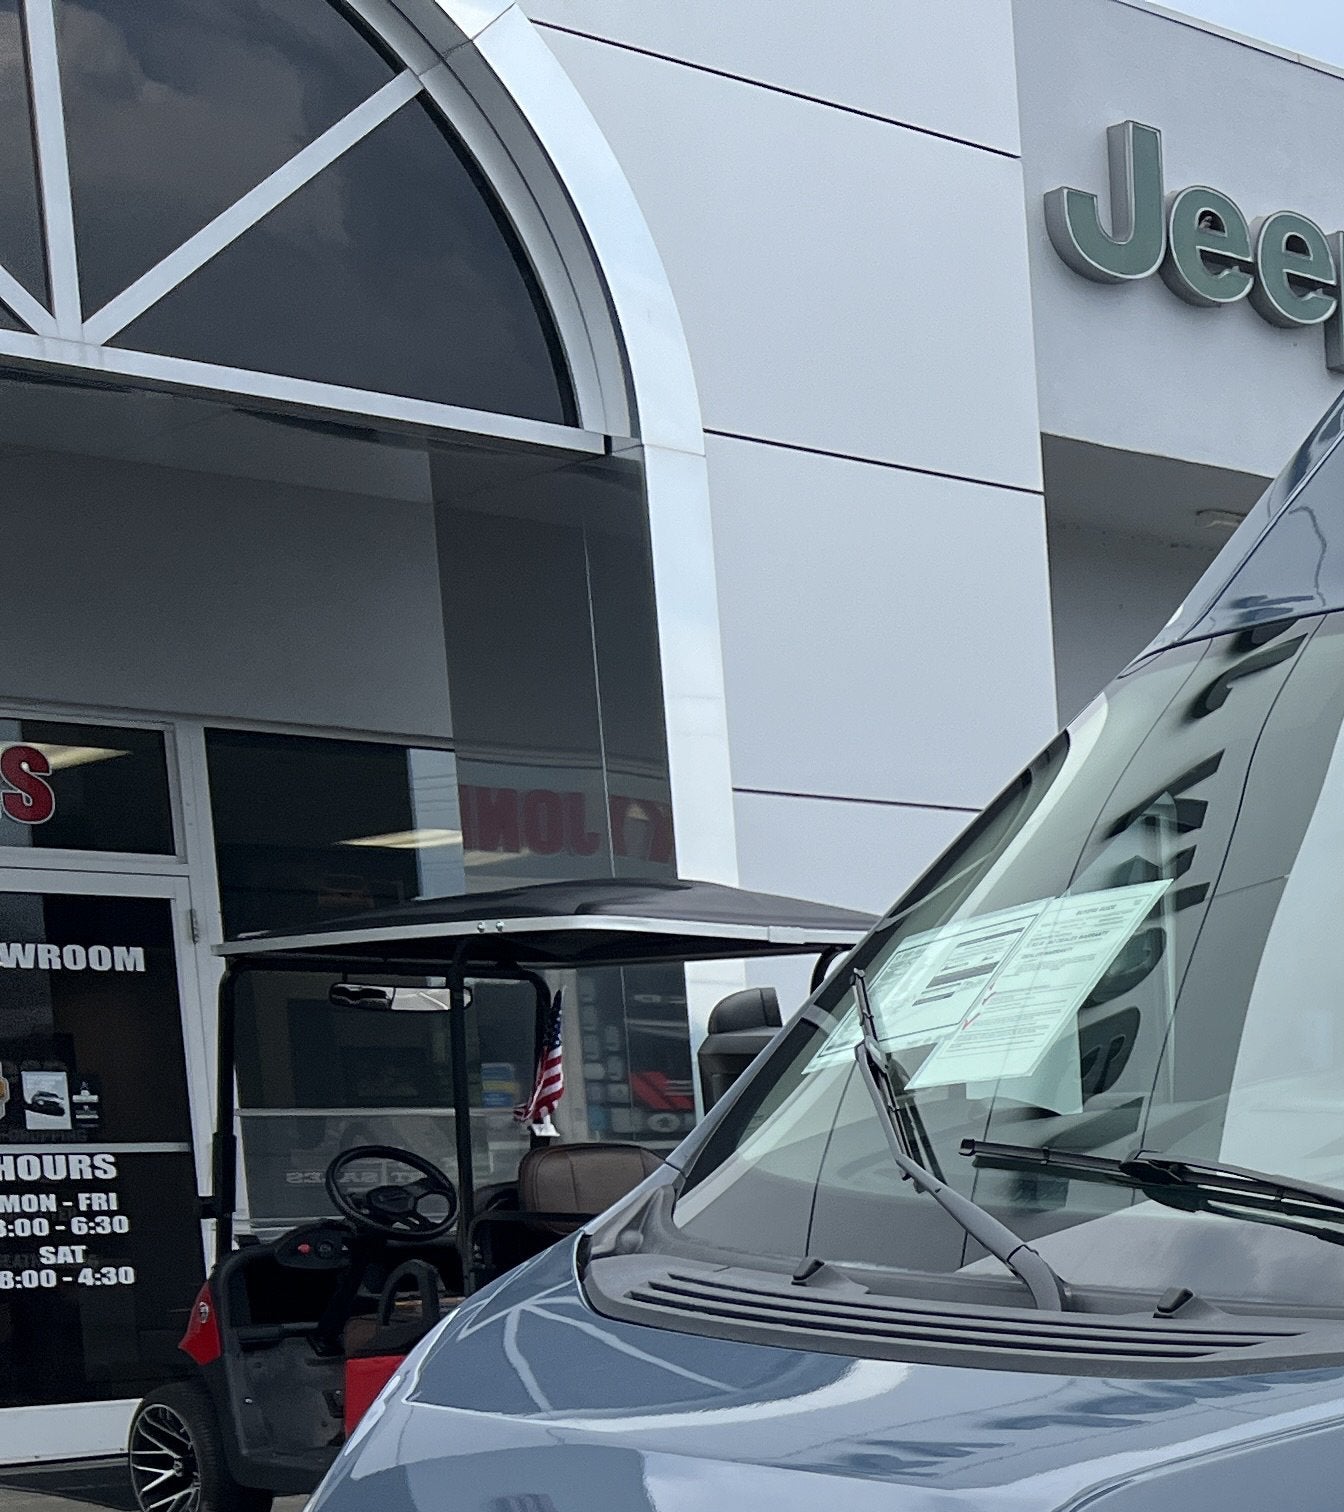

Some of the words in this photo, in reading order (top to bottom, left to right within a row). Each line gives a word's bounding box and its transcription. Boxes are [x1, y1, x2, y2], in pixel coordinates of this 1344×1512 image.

[0, 1193, 57, 1213] MON
[78, 1192, 119, 1212] FRI
[70, 1215, 130, 1235] 6:30
[39, 1245, 88, 1265] SAT
[78, 1266, 136, 1286] 4:30
